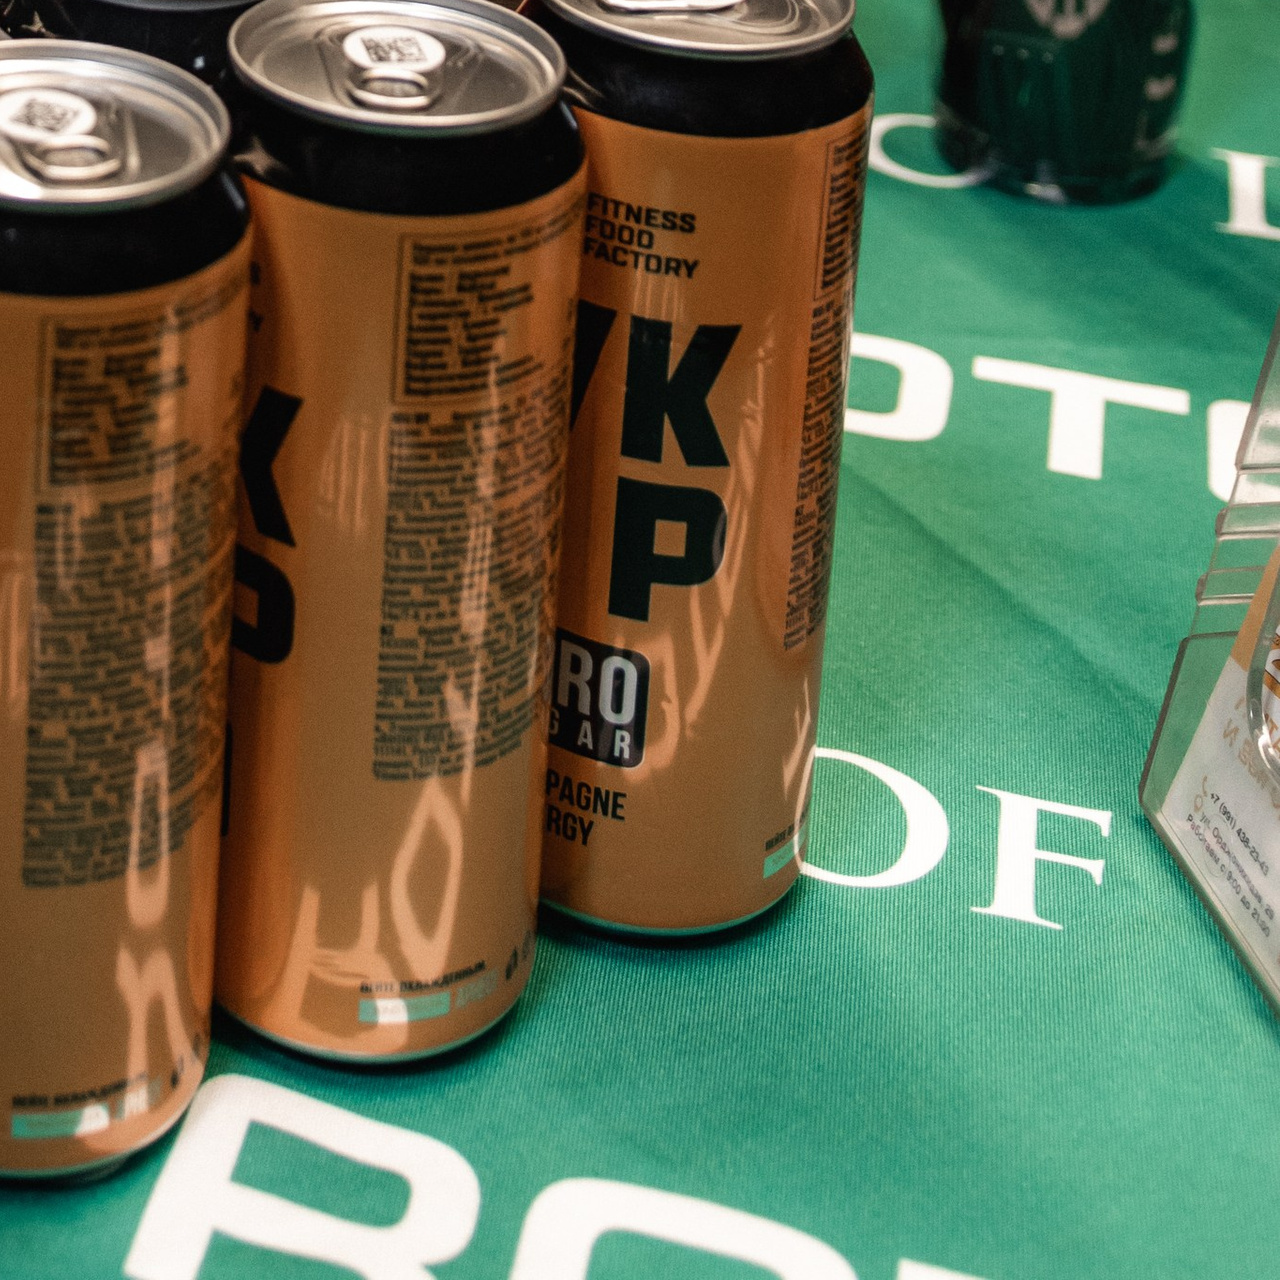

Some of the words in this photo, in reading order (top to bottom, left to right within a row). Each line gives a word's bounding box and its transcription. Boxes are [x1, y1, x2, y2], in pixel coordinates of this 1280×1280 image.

[585, 215, 654, 251] FOOD
[588, 192, 696, 234] FITNESS
[583, 236, 700, 279] FACTORY
[608, 475, 728, 623] P
[556, 639, 638, 726] RO
[800, 746, 1113, 931] OF
[1209, 792, 1221, 804] +7
[1219, 802, 1237, 830] (991)
[1185, 813, 1220, 866] Работаем
[1240, 894, 1251, 911] до
